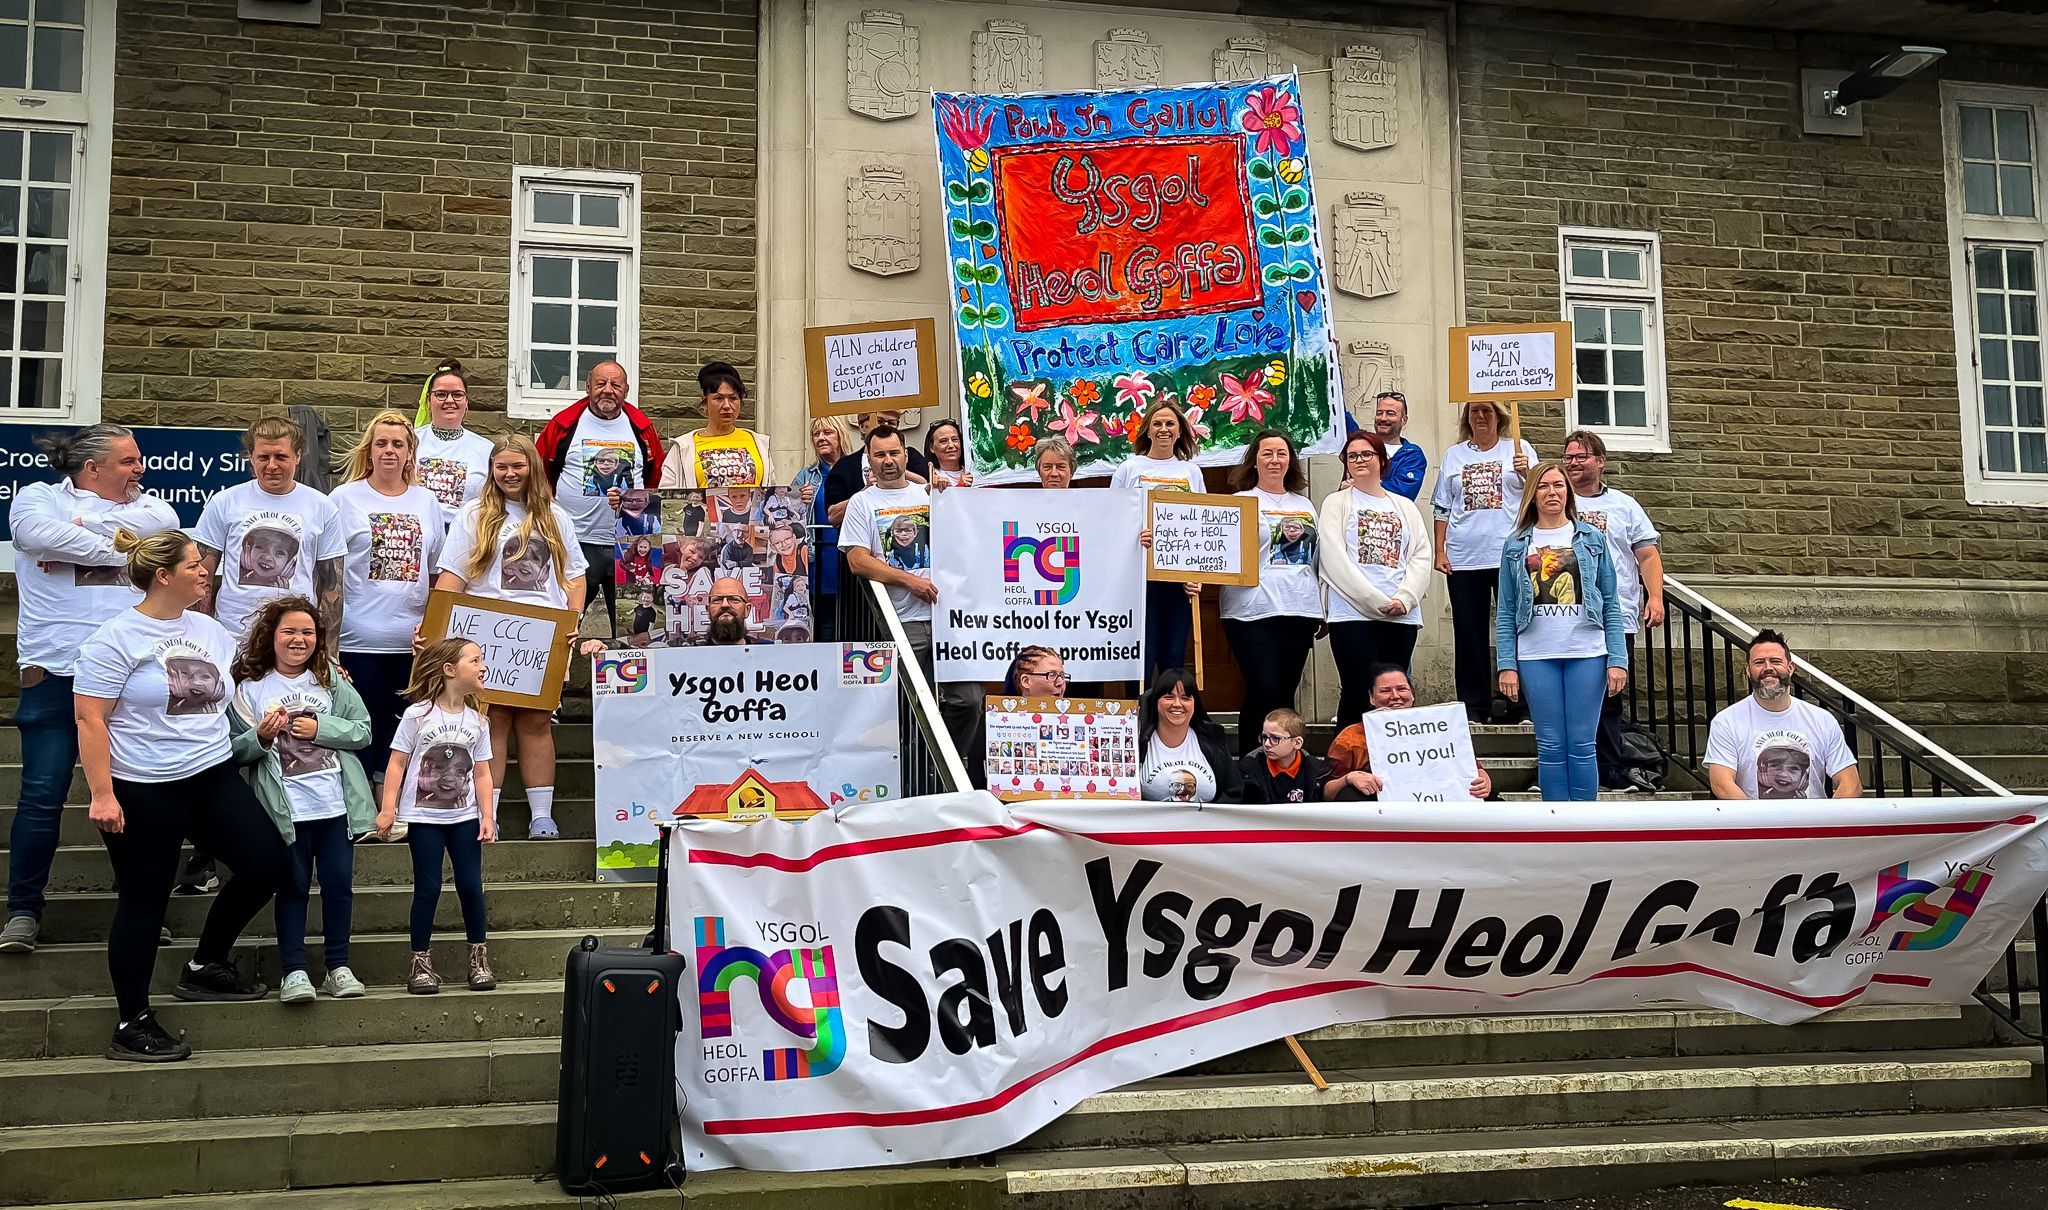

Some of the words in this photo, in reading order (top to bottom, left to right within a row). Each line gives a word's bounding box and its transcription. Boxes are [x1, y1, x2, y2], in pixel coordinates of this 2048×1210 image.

[1004, 104, 1068, 138] Pawb
[1127, 98, 1230, 136] Gallu!
[1051, 154, 1209, 234] Ysgol
[1018, 252, 1123, 310] Heol
[1125, 242, 1246, 312] Goffa
[1215, 316, 1287, 353] Love
[829, 338, 862, 359] ALN
[867, 338, 918, 355] children
[1471, 340, 1493, 356] Why
[1500, 341, 1520, 350] are
[835, 360, 882, 376] deserve
[892, 358, 907, 367] an
[1488, 350, 1521, 368] ALN
[833, 369, 905, 392] EDUCATION
[1476, 368, 1517, 378] children
[1522, 366, 1549, 379] being
[858, 385, 885, 398] too!
[0, 447, 53, 468] Croe
[199, 456, 214, 477] y
[138, 484, 215, 508] ounty
[1155, 507, 1174, 521] We
[1180, 508, 1198, 521] will
[1201, 508, 1240, 524] ALWAYS
[383, 529, 412, 538] SAVE
[1036, 522, 1079, 534] YSGOL
[1155, 525, 1179, 541] fight
[1184, 527, 1198, 538] for
[1201, 526, 1228, 538] HEOL
[384, 539, 411, 549] HEOL
[1155, 540, 1191, 552] GOFFA
[1194, 542, 1201, 550] +
[1204, 540, 1227, 552] OUR
[377, 548, 416, 559] GOFFA!
[1156, 553, 1179, 566] ALN
[1199, 560, 1227, 572] needs!
[1004, 586, 1027, 594] HEOL
[1004, 597, 1033, 606] GOFFA
[452, 611, 481, 636] WE
[493, 618, 531, 642] CCC
[665, 604, 766, 636] HEL
[950, 609, 988, 629] New
[992, 609, 1050, 629] school
[1054, 610, 1081, 630] for
[1085, 608, 1133, 634] Ysgol
[936, 640, 977, 661] Heol
[981, 641, 1026, 661] Goff
[1060, 640, 1141, 665] promised
[669, 670, 746, 702] Ysgol
[755, 668, 819, 693] Heol
[702, 697, 787, 723] Goffa
[671, 734, 722, 743] DESERVE
[738, 732, 764, 741] NEW
[768, 730, 820, 740] SCHOOL!
[1384, 720, 1449, 738] Shame
[1387, 750, 1411, 765] on
[1416, 742, 1456, 767] you!
[755, 920, 830, 944] YSGOL
[1849, 935, 1881, 947] OL
[854, 904, 1069, 1064] Save
[1084, 855, 1363, 1002] Ysgol
[1359, 878, 1614, 979] Heol
[1845, 950, 1885, 966] GOFFA
[703, 1043, 747, 1061] HEOL
[704, 1067, 760, 1084] GOFFA
